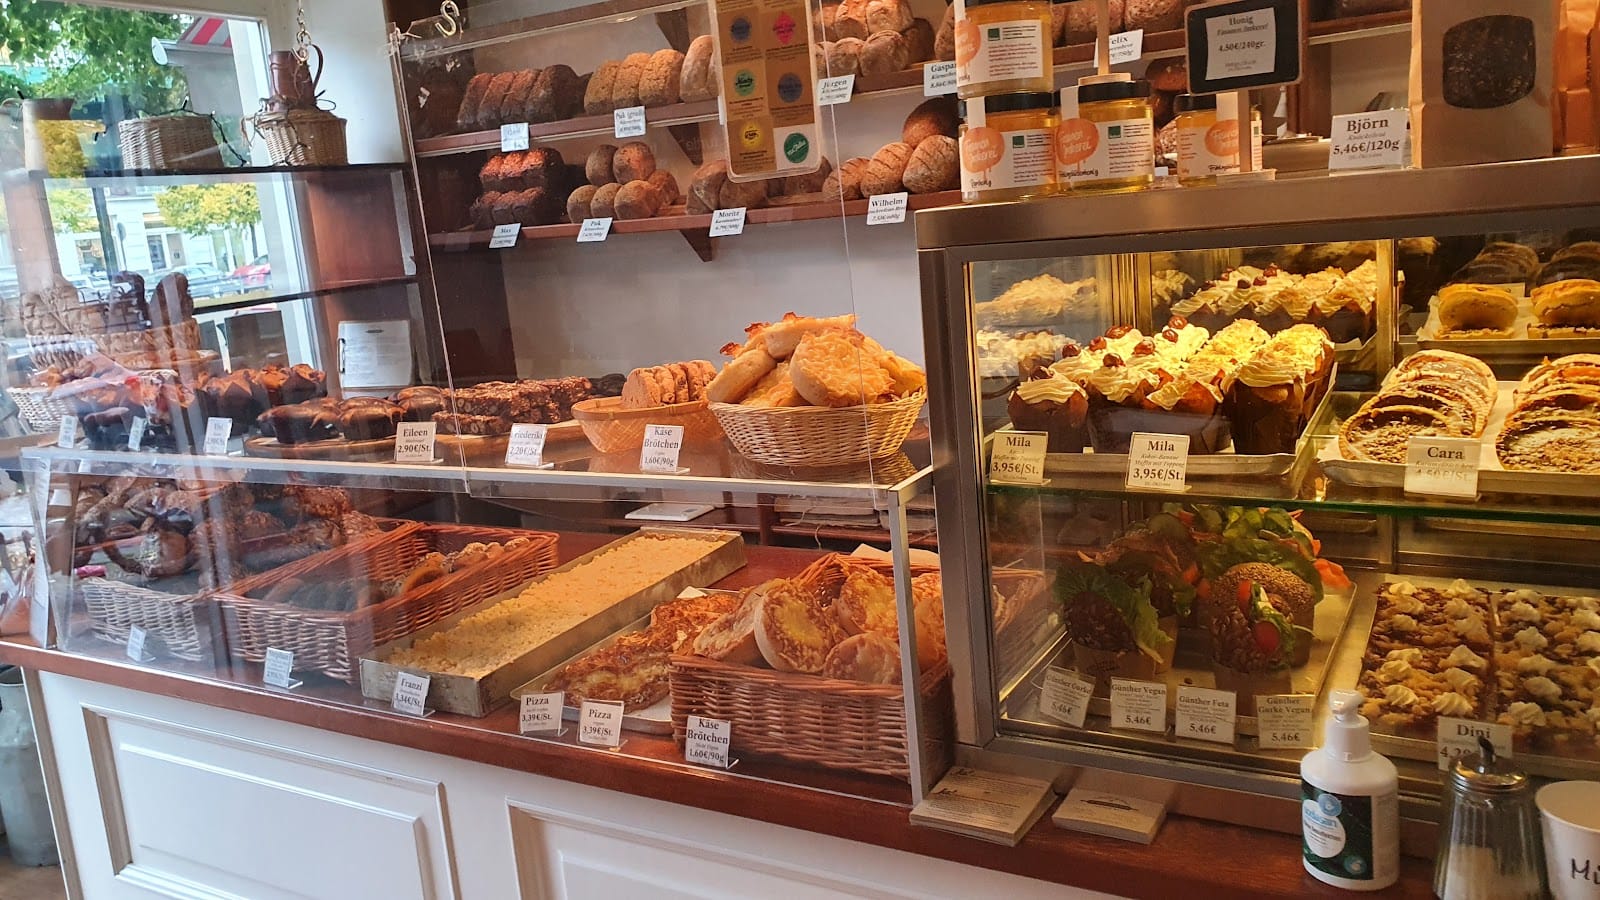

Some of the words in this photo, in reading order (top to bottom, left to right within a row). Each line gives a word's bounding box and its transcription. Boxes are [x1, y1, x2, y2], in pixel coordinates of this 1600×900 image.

[1229, 16, 1253, 26] Honig
[1347, 118, 1389, 134] Björn
[1333, 140, 1400, 155] 5,46€/120g
[871, 198, 903, 208] Wilhelm
[718, 210, 740, 219] Moritz
[403, 428, 428, 437] Eileen
[654, 426, 673, 436] Käse
[644, 438, 679, 449] Brötchen
[1006, 436, 1031, 447] Mila
[1147, 440, 1175, 452] Mila
[1427, 446, 1463, 460] Cara
[401, 678, 423, 692] Franzi
[1111, 683, 1142, 693] Günther
[1144, 686, 1166, 695] Vegan
[526, 697, 549, 706] Pizza
[1178, 695, 1211, 705] Günther
[1212, 698, 1230, 708] Feta
[588, 709, 612, 720] Pizza
[1285, 706, 1311, 714] Vegan
[698, 718, 720, 731] Käse
[1456, 724, 1492, 739] Dini
[687, 730, 728, 745] Brötchen
